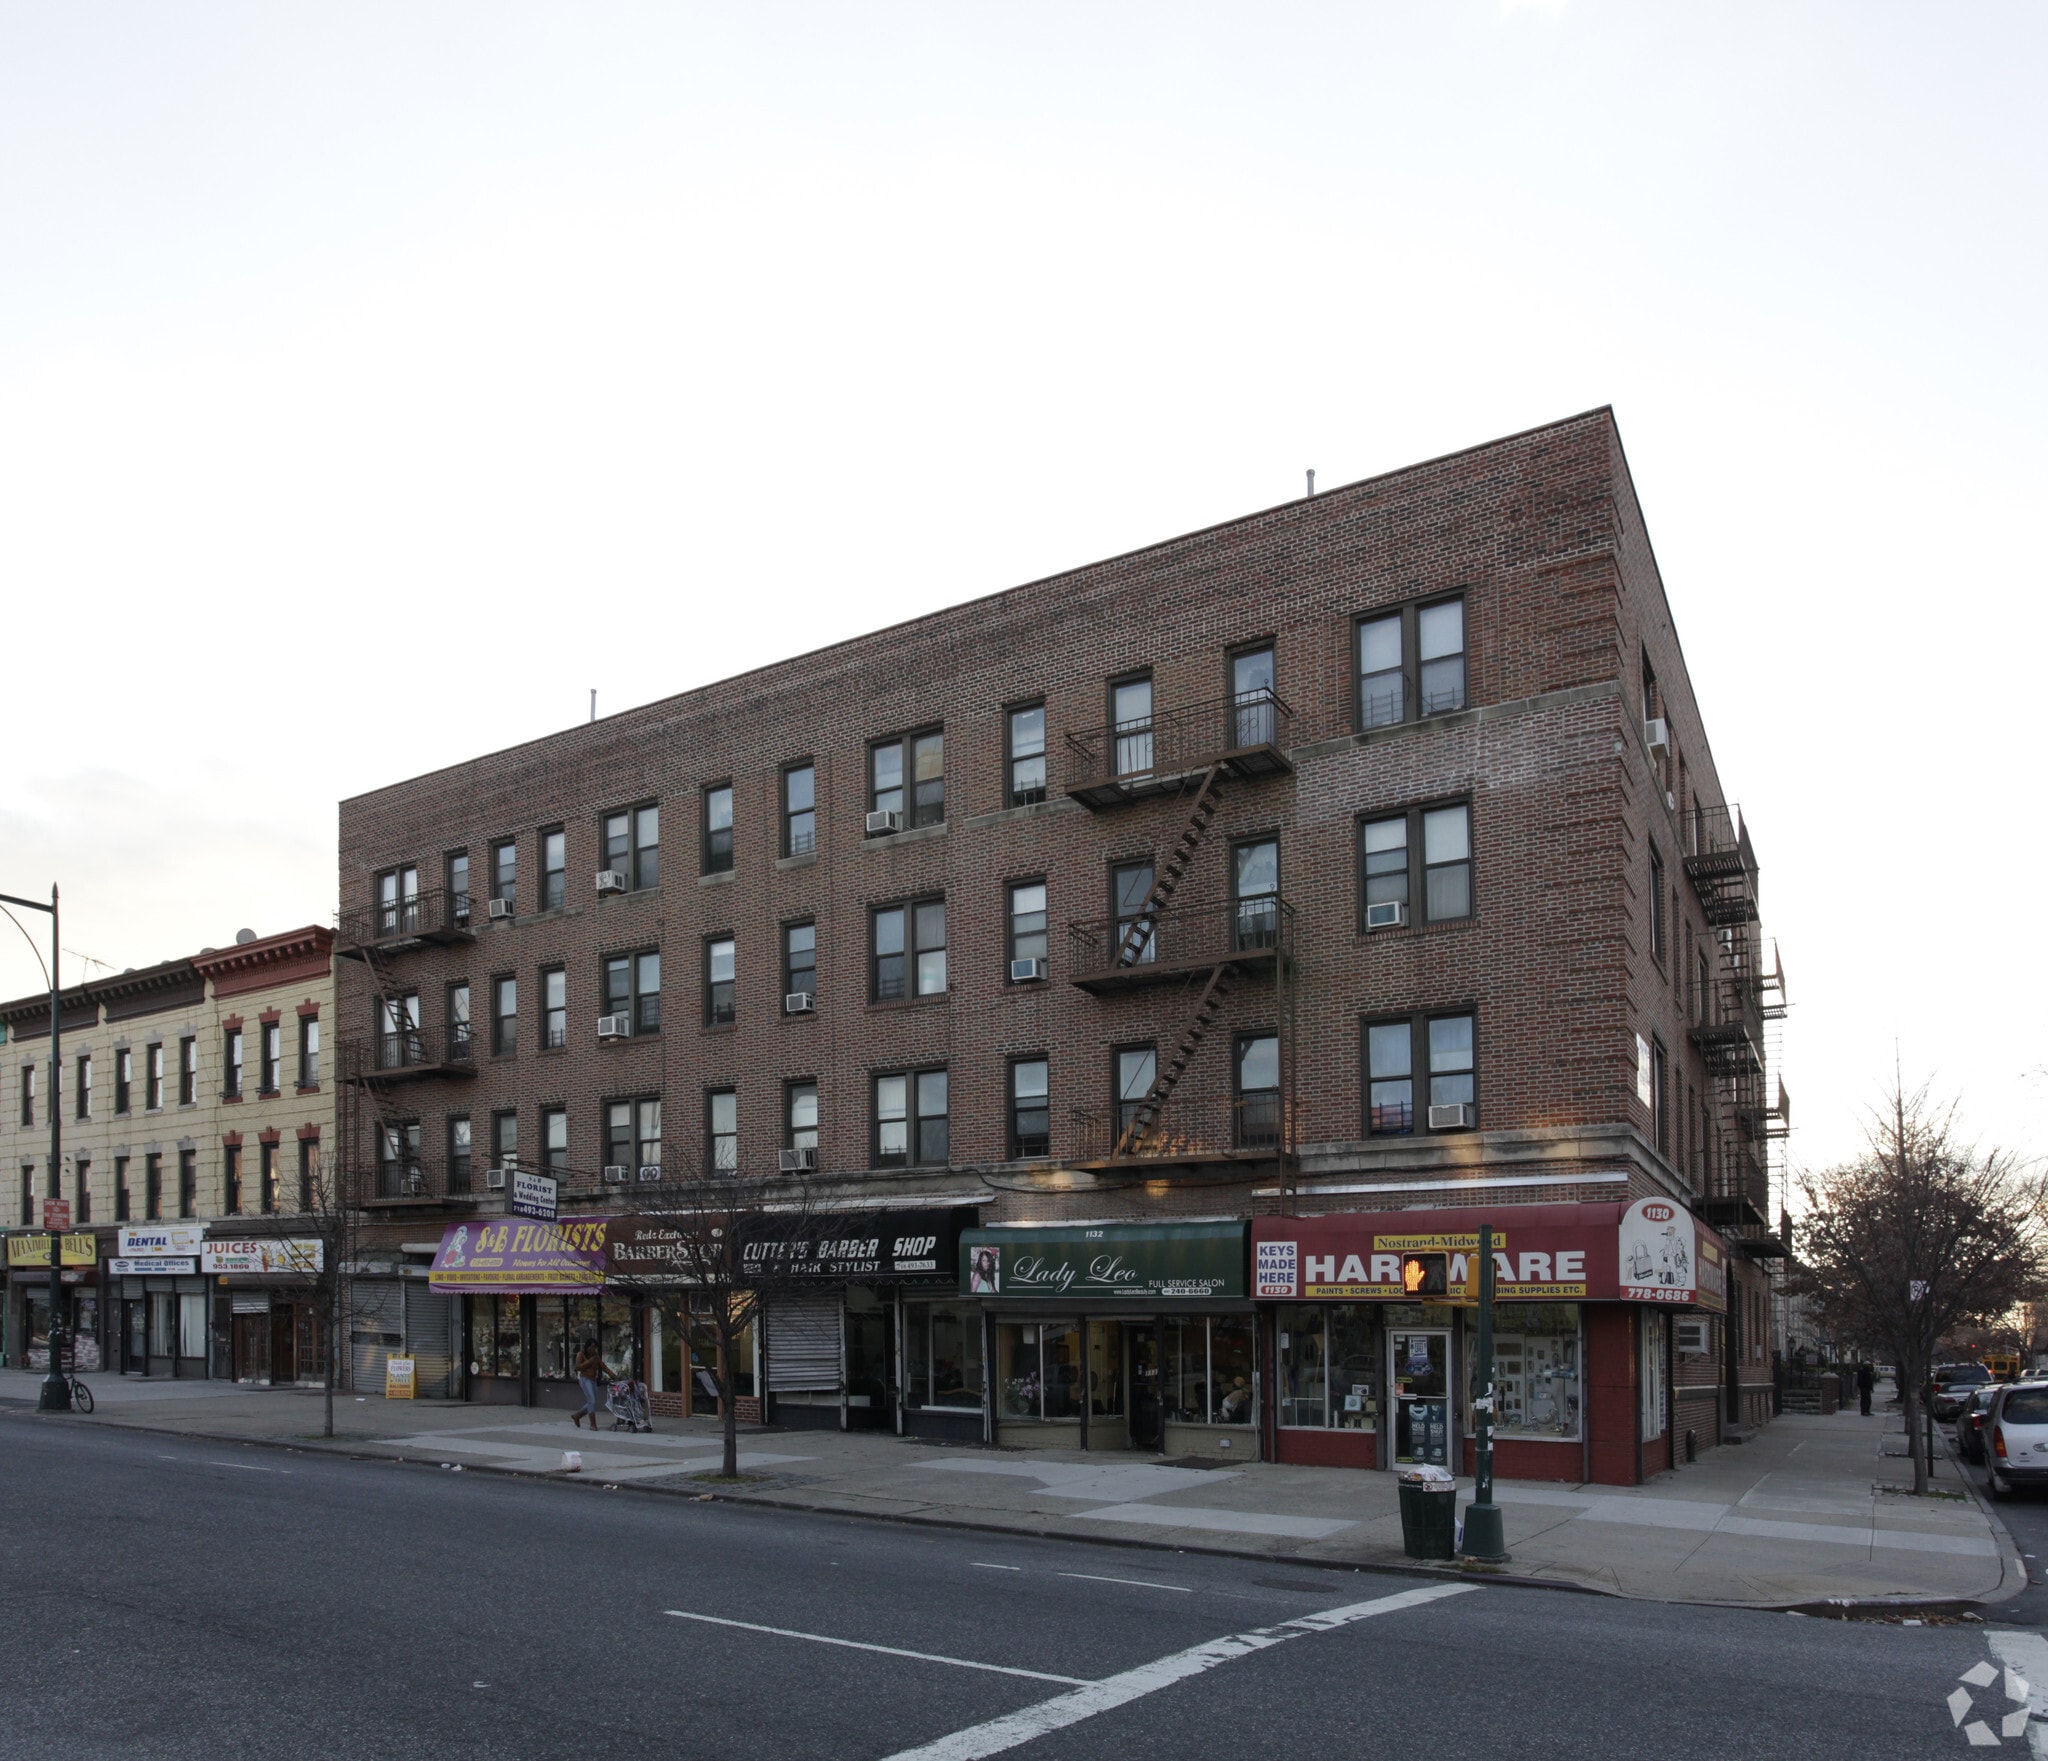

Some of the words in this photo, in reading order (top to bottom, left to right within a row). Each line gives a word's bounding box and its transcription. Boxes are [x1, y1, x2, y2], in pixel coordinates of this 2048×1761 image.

[516, 1181, 552, 1194] FLORIST
[519, 1191, 539, 1204] Wedding
[540, 1196, 555, 1205] Center
[1647, 1208, 1670, 1220] 1130
[475, 1226, 509, 1253] S&B
[510, 1223, 607, 1253] FLORISTS
[658, 1229, 699, 1240] Exclu
[65, 1236, 93, 1257] BELL'S
[127, 1237, 168, 1247] DENTAL
[206, 1242, 257, 1254] JUICES
[817, 1238, 879, 1259] BARBER
[892, 1236, 937, 1257] SHOP
[1378, 1235, 1501, 1249] Nostrand-Midwd
[1260, 1246, 1294, 1256] KEYS
[791, 1263, 821, 1273] HAIR
[830, 1261, 880, 1272] STYLIST
[1258, 1259, 1296, 1269] MADE
[1305, 1251, 1586, 1283] HARARE
[1009, 1255, 1077, 1293] Lady
[1085, 1254, 1138, 1283] Leo
[1259, 1272, 1294, 1283] HERE
[1148, 1280, 1165, 1288] FULL
[1167, 1279, 1198, 1287] SERVICE
[1200, 1279, 1224, 1287] SALON
[1264, 1286, 1289, 1294] 1130
[1519, 1286, 1560, 1294] SUPPLIES
[1563, 1286, 1583, 1294] ETC.
[1628, 1288, 1690, 1302] 778-0686
